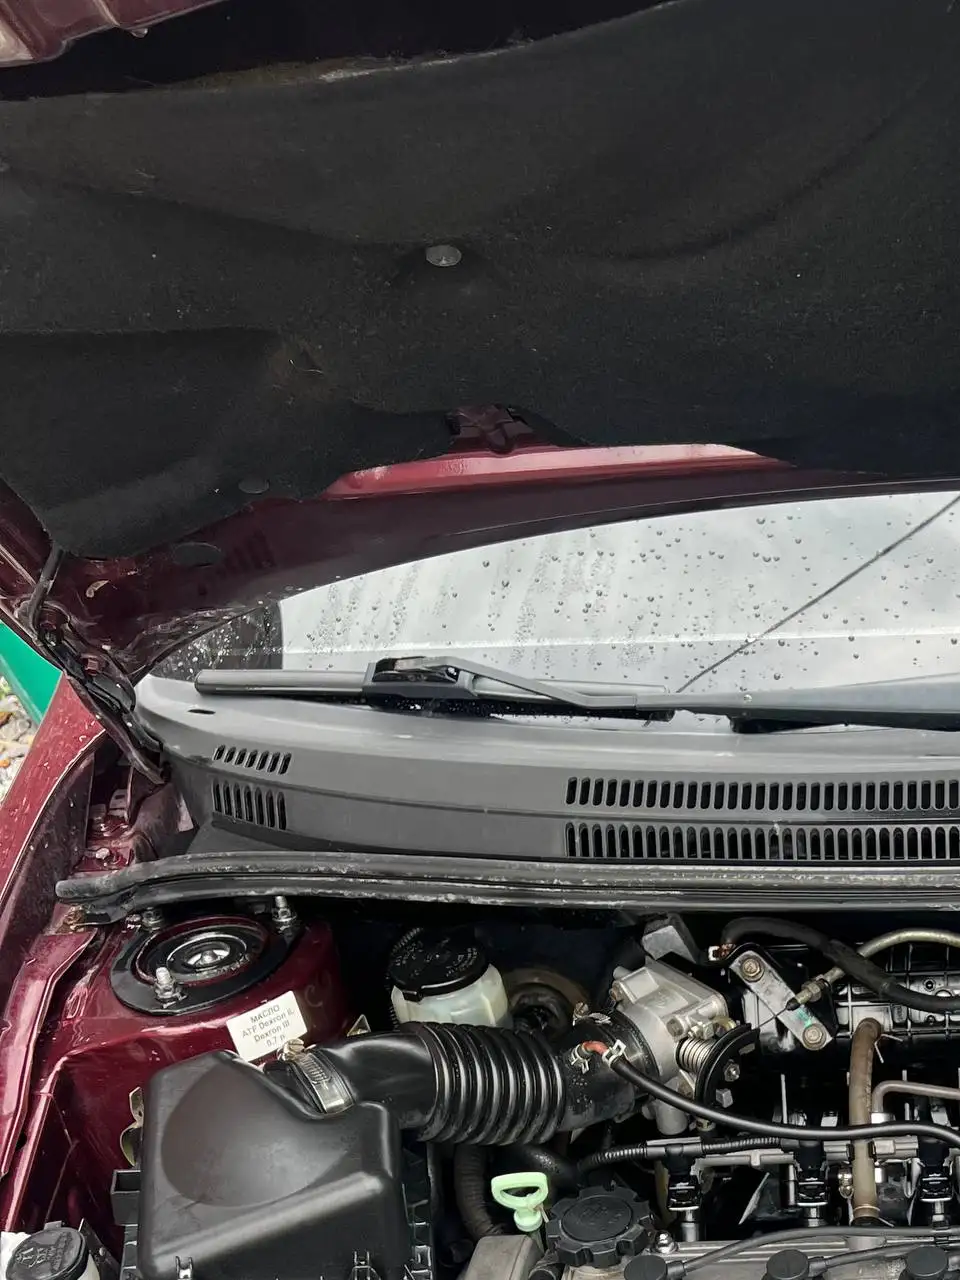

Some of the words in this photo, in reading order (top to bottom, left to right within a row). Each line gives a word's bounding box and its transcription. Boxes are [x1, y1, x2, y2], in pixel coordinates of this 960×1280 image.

[250, 1005, 280, 1023] МАСЛО
[242, 1026, 257, 1038] ATF
[259, 1013, 286, 1029] Dexron
[254, 1025, 282, 1042] Dexron
